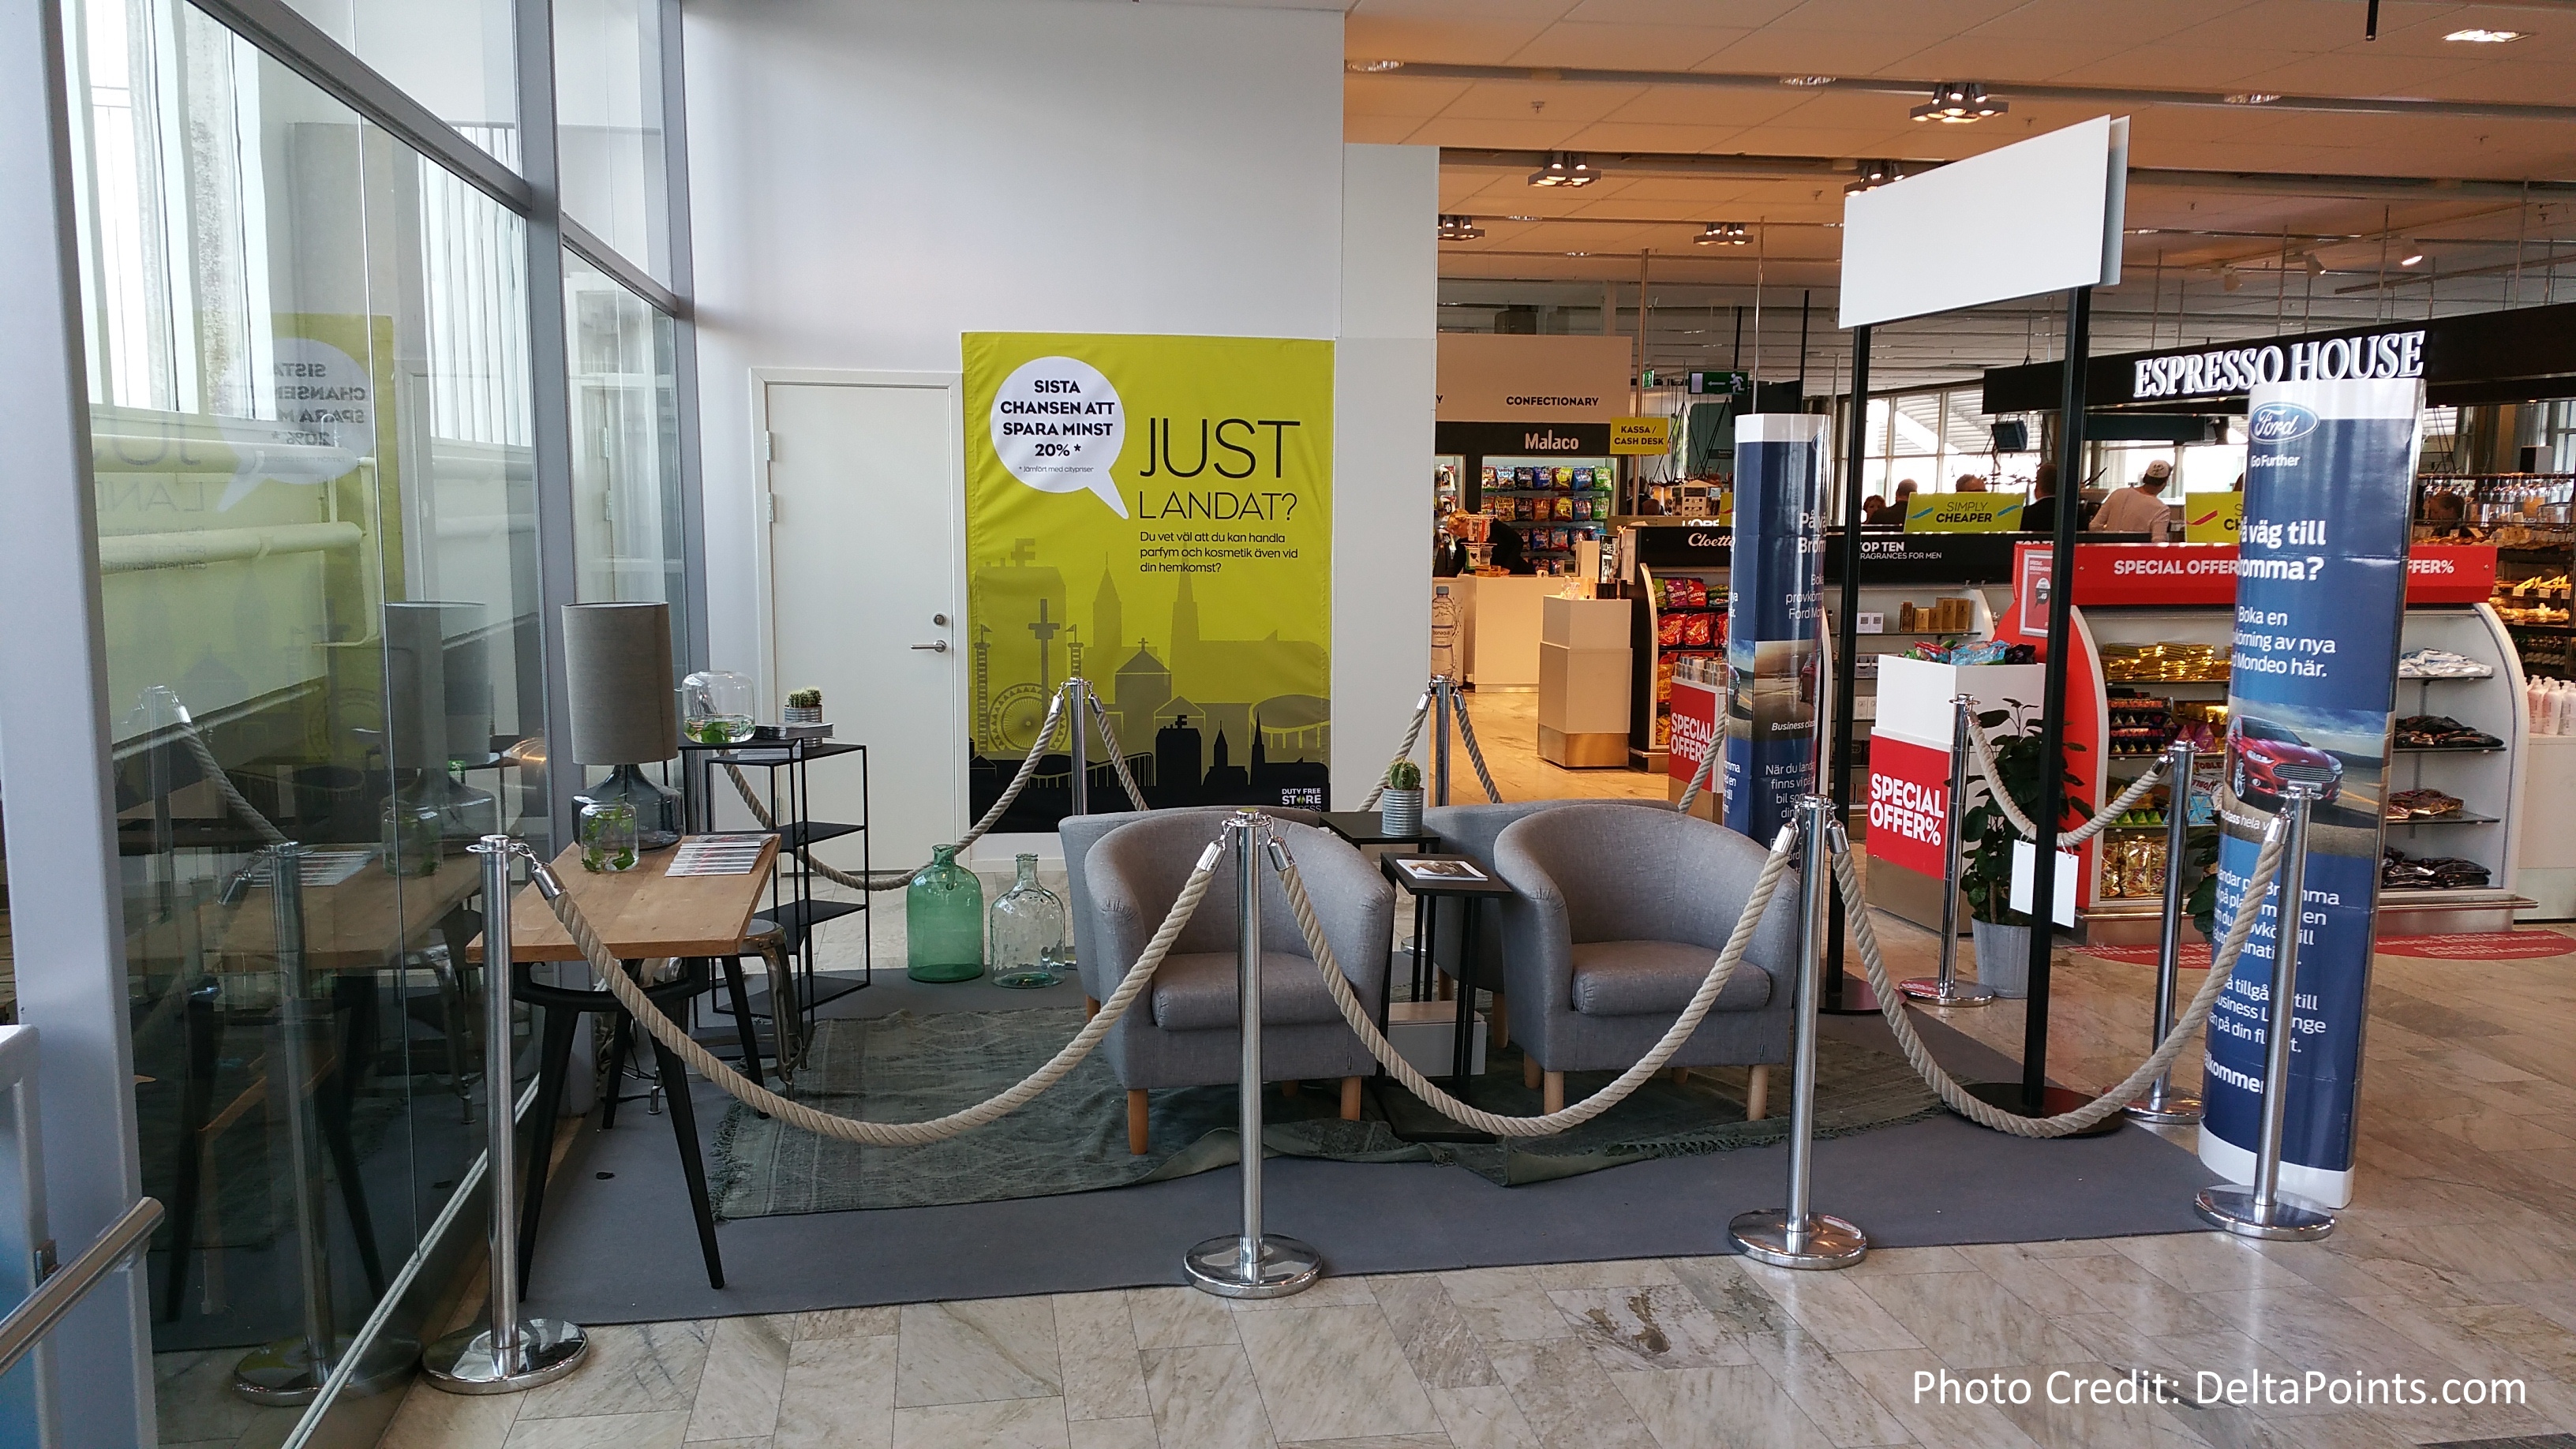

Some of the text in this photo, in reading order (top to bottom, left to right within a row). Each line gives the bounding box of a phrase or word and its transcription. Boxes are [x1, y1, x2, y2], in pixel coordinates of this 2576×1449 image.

[2133, 330, 2425, 398] ESPRESSO HOUSE
[1034, 380, 1080, 394] SISTA
[1000, 401, 1115, 415] CHANSEN ATT
[1506, 396, 1599, 406] CONFECTIONARY
[1002, 422, 1114, 436] SPARA MINST
[1620, 425, 1650, 434] KASSA
[2254, 409, 2300, 436] Ford
[1525, 429, 1579, 450] Malaco
[1034, 444, 1070, 457] 20%
[1140, 417, 1301, 479] JUST
[2261, 454, 2301, 467] Further
[1140, 491, 1297, 521] LANDAT?
[1946, 501, 1988, 512] SIMPLY
[1936, 513, 1993, 523] CHEAPER
[1140, 532, 1286, 544] Du vet väl att du kan handla
[2250, 519, 2283, 549] väg
[2287, 519, 2327, 545] till
[1798, 537, 1826, 553] Brom
[1860, 541, 1905, 552] OP TEN
[1140, 547, 1298, 560] parfym och kosmetik även vid
[1140, 562, 1222, 573] din hemkomst?
[2114, 560, 2239, 575] SPECIAL OFFER
[2237, 553, 2324, 581] romma?
[2408, 560, 2454, 575] FFER%
[1788, 606, 1810, 620] Ford
[2238, 606, 2288, 626] Boka en
[2274, 637, 2297, 651] av
[2300, 638, 2336, 656] nya
[2237, 653, 2287, 674] Mondeo
[2291, 658, 2327, 677] här.
[1671, 712, 1713, 744] SPECIAL
[1771, 719, 1805, 732] Business
[1765, 764, 1784, 776] När
[1786, 762, 1798, 774] du
[2194, 761, 2224, 769] TOBLE
[1771, 777, 1795, 789] finns
[1796, 778, 1803, 788] vi
[1776, 793, 1788, 803] bil
[1870, 773, 1945, 818] SPECIAL
[1870, 801, 1941, 847] OFFER%
[2241, 814, 2260, 829] hela
[2218, 869, 2241, 887] andar
[2302, 911, 2327, 925] en
[2222, 910, 2233, 927] du
[2298, 929, 2314, 945] ill
[2235, 978, 2270, 1002] tillgå
[2294, 993, 2319, 1011] till
[2215, 994, 2259, 1019] usiness
[2218, 1016, 2230, 1034] på
[2232, 1021, 2252, 1041] din
